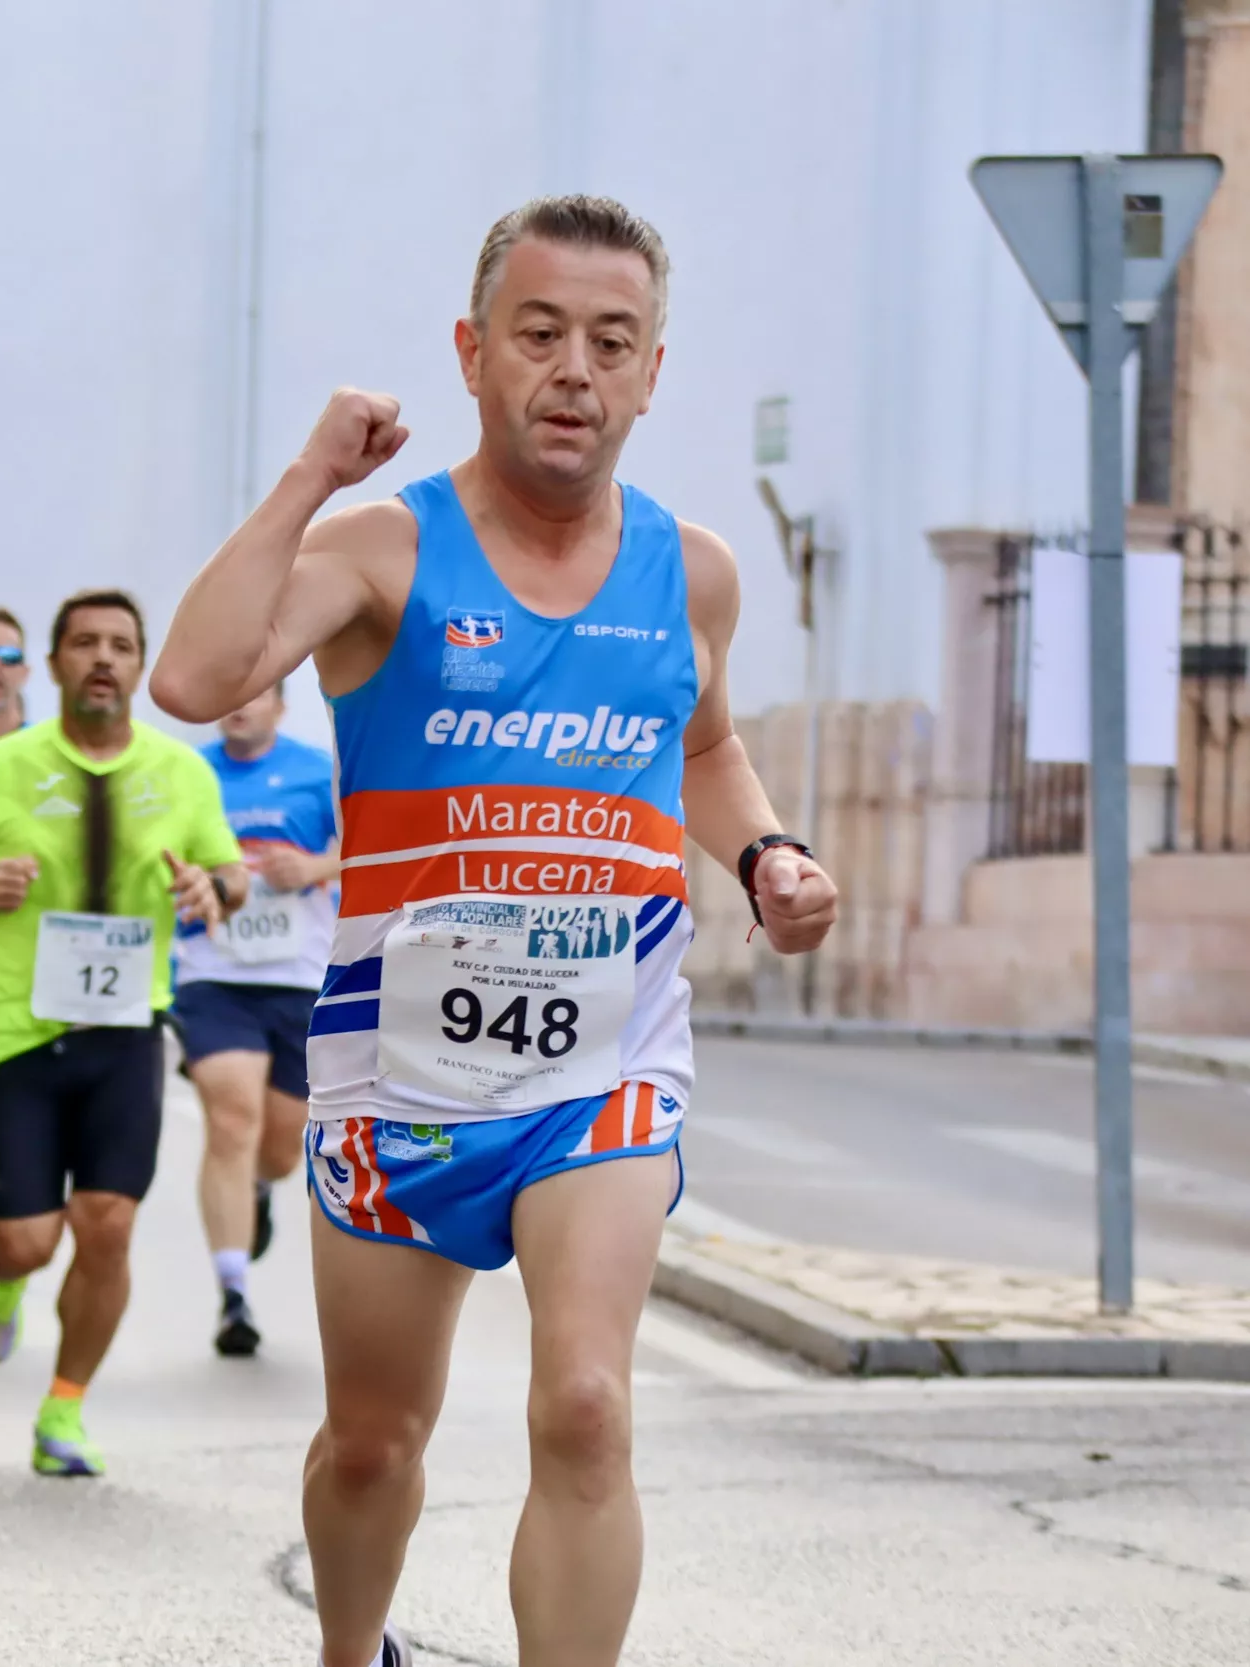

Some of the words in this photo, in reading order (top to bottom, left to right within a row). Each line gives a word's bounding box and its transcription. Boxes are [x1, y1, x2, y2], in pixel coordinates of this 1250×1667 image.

[574, 624, 650, 641] GSPORT
[424, 705, 665, 759] enerplus
[555, 749, 652, 770] directo
[446, 792, 634, 842] Maratón
[457, 854, 616, 894] Lucena
[450, 902, 510, 916] PROVINCIAL
[513, 905, 527, 917] DE
[460, 911, 527, 929] POPULARES
[529, 904, 590, 932] 2024
[452, 960, 472, 970] XXV
[493, 965, 529, 976] CIUDAD
[530, 968, 543, 978] DE
[544, 969, 580, 979] LUCENA
[77, 965, 120, 996] 12
[471, 975, 490, 985] POR
[492, 978, 505, 987] LA
[507, 980, 557, 991] IGUALDAD
[441, 987, 580, 1059] 948
[436, 1056, 493, 1076] FRANCISCO
